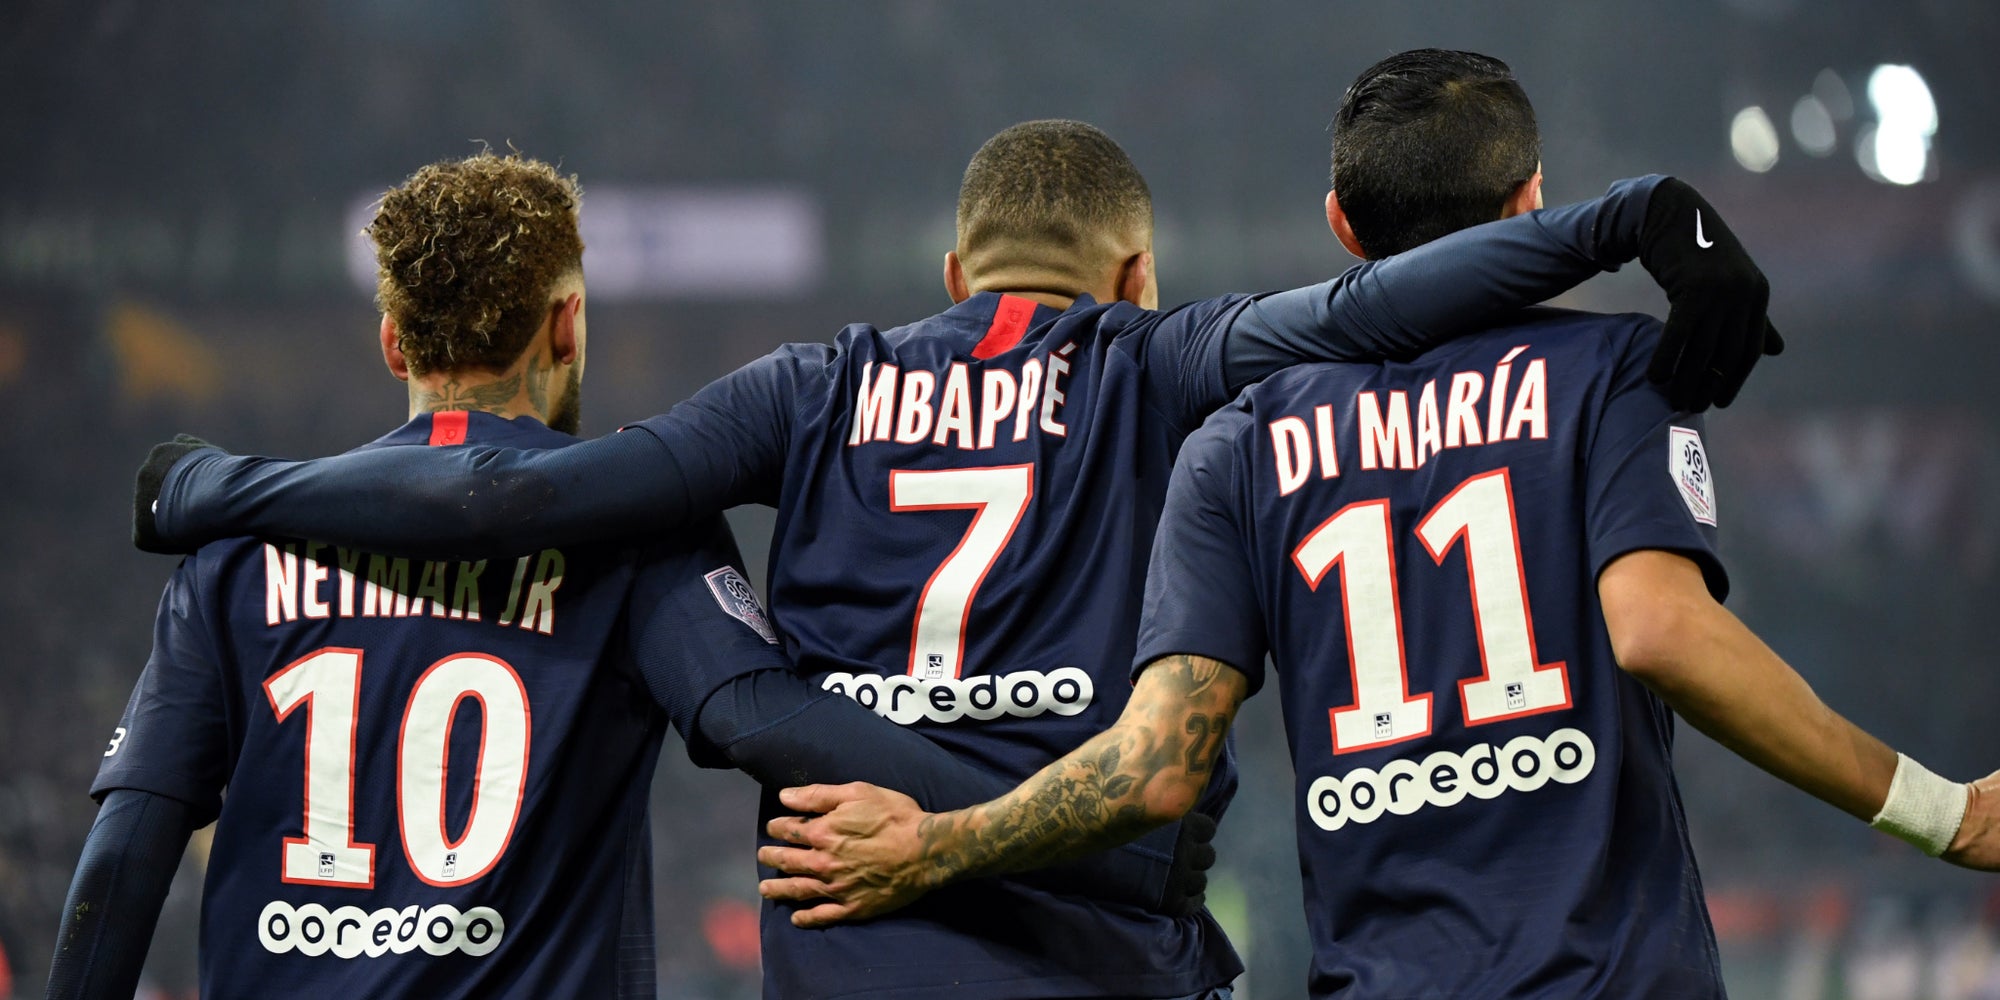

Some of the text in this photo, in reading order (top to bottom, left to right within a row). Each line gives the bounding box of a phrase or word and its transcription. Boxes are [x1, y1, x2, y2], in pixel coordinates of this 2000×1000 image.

[848, 340, 1079, 450] MBAPPÉ
[1268, 344, 1548, 497] DI MARÍA
[264, 539, 566, 636] NEYMAR JR
[889, 462, 1035, 680] 7
[1291, 466, 1574, 756] 11
[262, 646, 531, 889] 10
[1316, 738, 1585, 820] ooredoo
[266, 904, 494, 948] ooredoo
